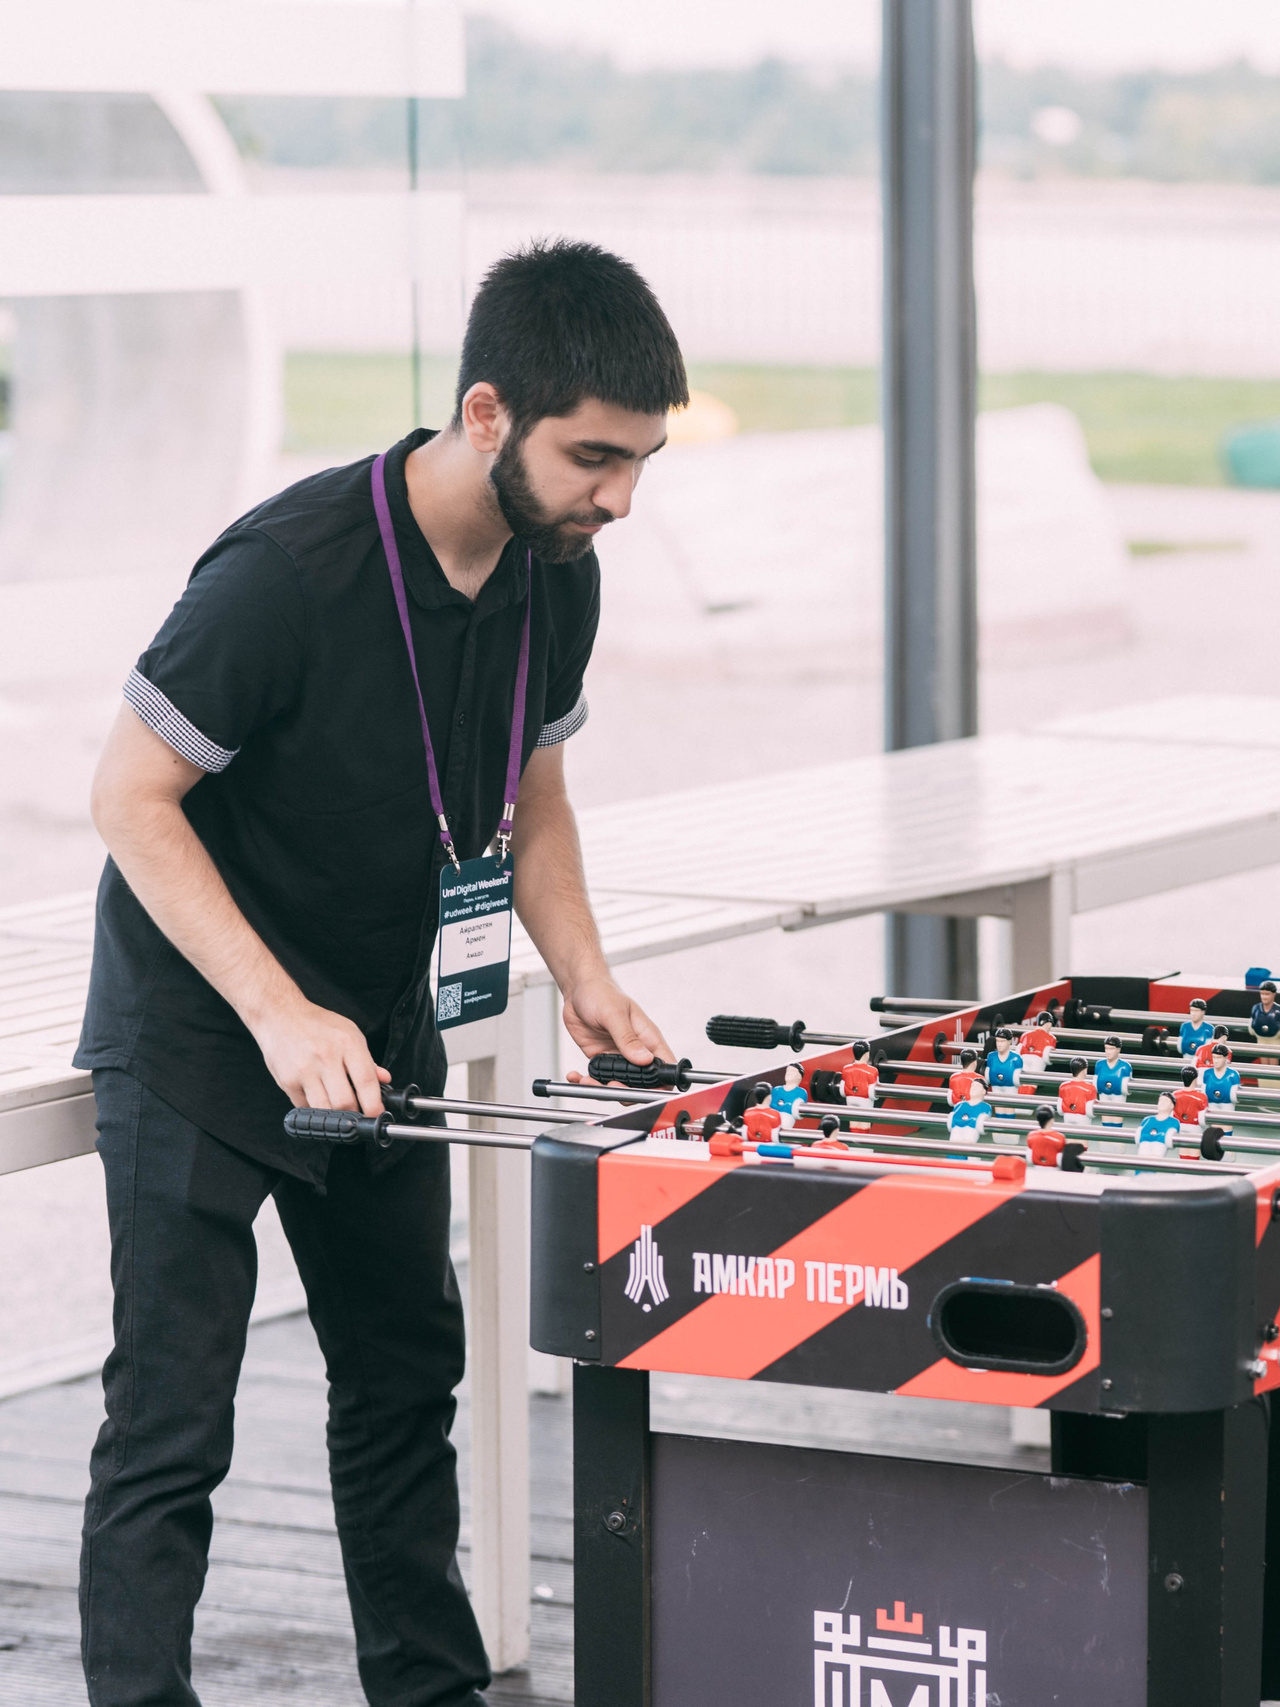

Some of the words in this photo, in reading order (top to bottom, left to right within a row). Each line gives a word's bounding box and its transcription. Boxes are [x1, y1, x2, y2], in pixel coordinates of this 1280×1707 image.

[442, 886, 456, 898] Ural
[456, 882, 478, 896] Digital
[478, 875, 509, 890] Weekend
[444, 905, 473, 919] #udweek
[474, 897, 509, 911] #digiweek
[459, 922, 493, 934] Айрапетян
[465, 935, 485, 945] Армен
[692, 1252, 796, 1299] АМКАР
[804, 1260, 909, 1310] ПЕРМЬ
